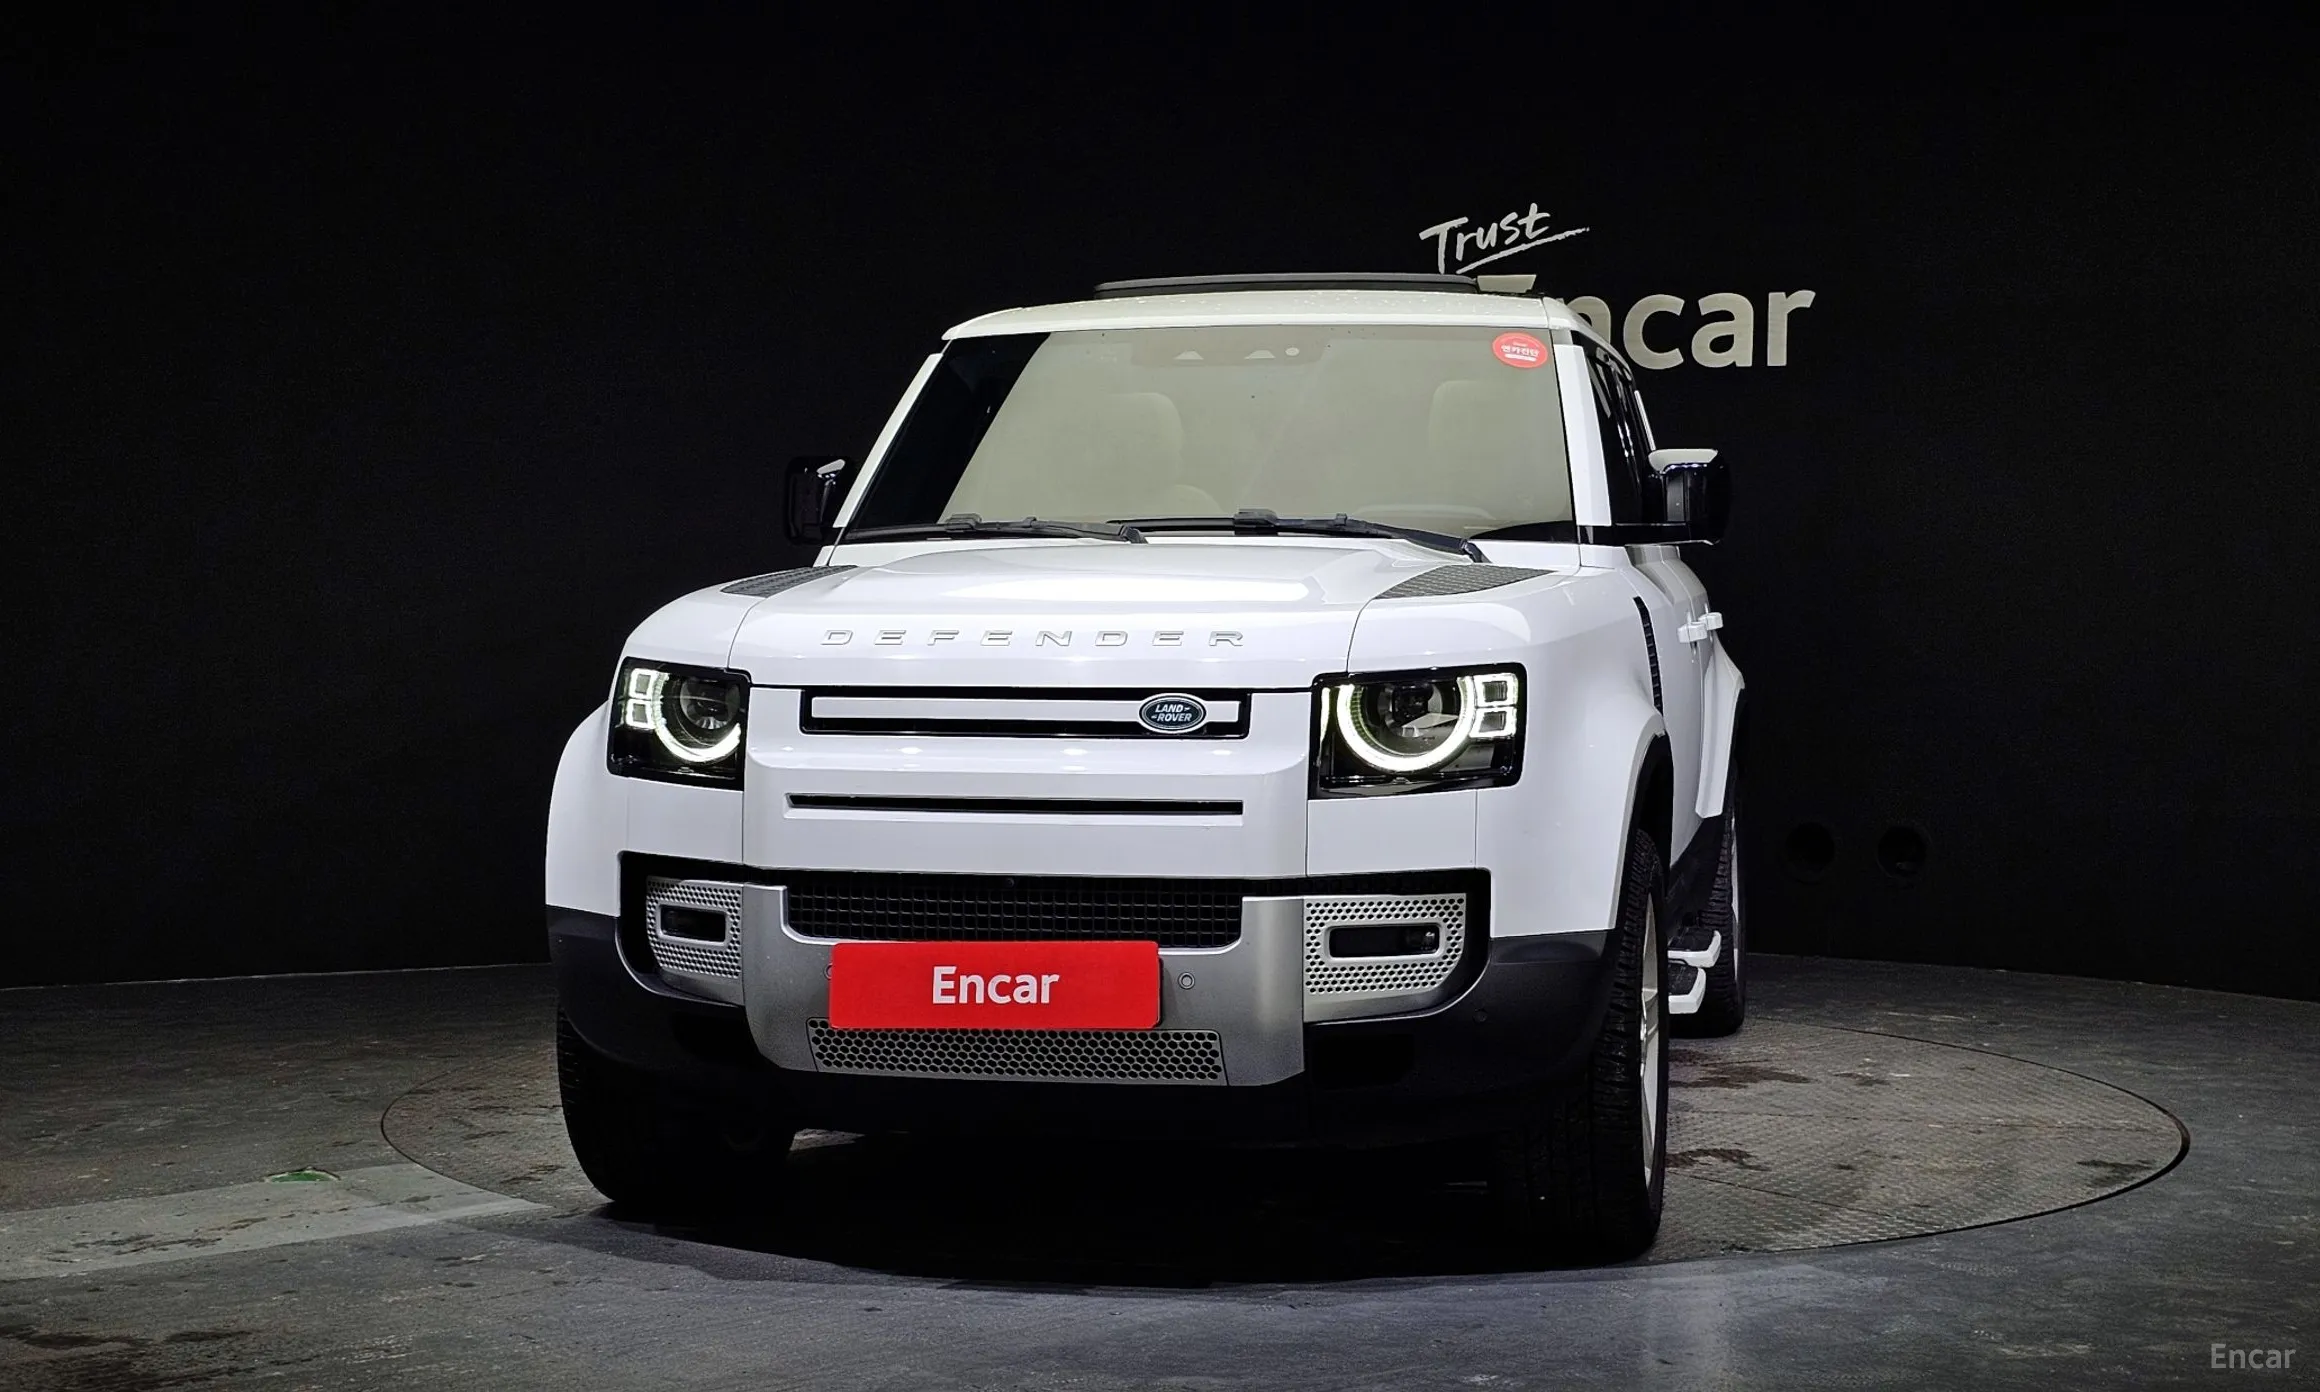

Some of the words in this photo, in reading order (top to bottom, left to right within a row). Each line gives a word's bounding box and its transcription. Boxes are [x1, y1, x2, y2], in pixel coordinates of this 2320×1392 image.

[1419, 202, 1551, 274] Trust
[819, 629, 1245, 647] DEFENDER
[1155, 704, 1183, 713] LAND
[1156, 713, 1192, 722] ROVER
[932, 965, 1060, 1005] Encar
